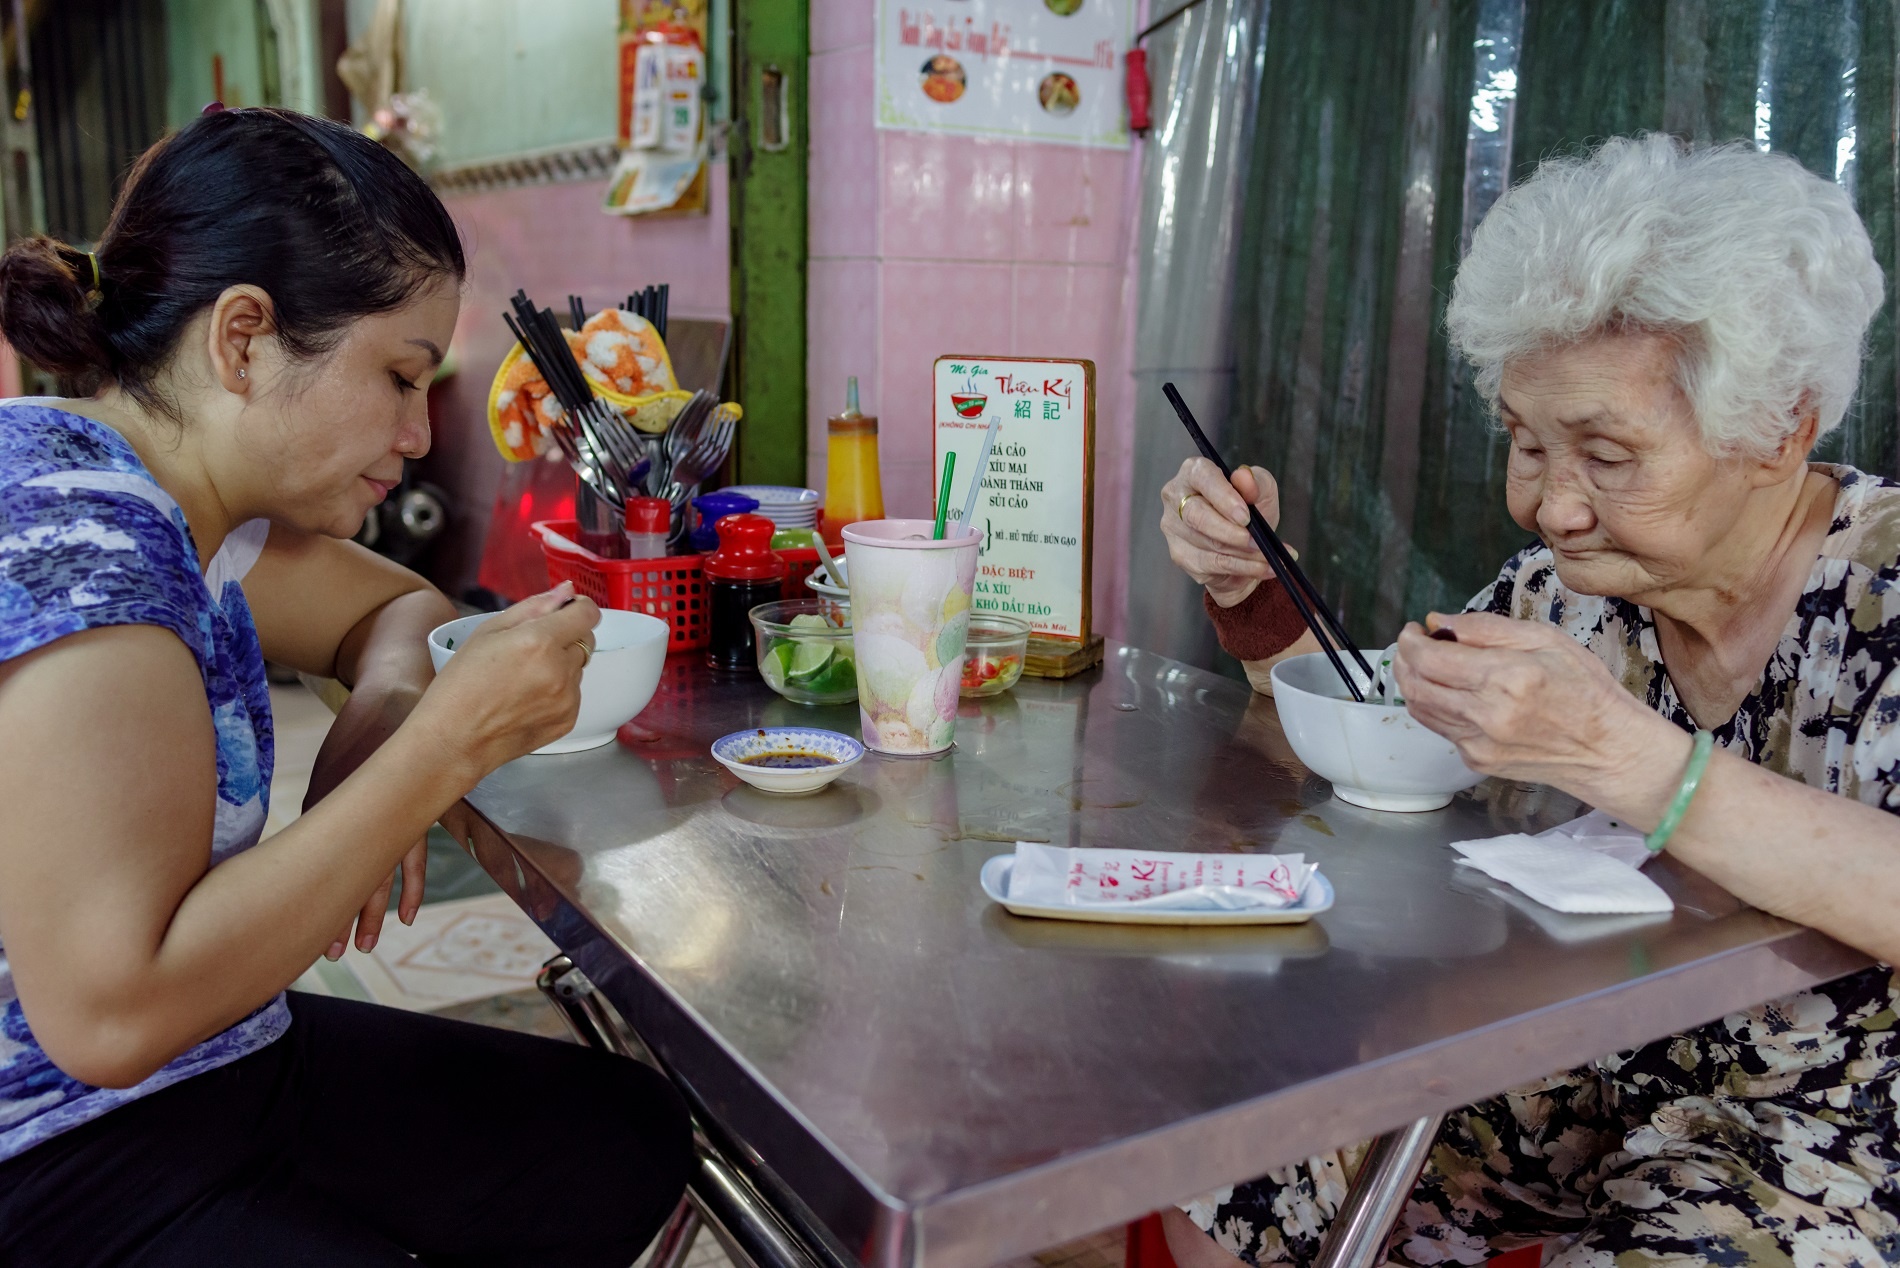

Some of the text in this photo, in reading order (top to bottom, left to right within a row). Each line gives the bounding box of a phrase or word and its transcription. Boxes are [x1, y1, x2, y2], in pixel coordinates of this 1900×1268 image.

[971, 365, 989, 377] Gia
[995, 373, 1073, 410] Thiệu Ký
[1006, 442, 1026, 457] CẢO
[989, 459, 1027, 476] XÍU MẠI
[980, 475, 1044, 492] OÀNH THÁNH
[989, 492, 1028, 509] SỦI CẢO
[1021, 530, 1039, 543] TIẾU
[1060, 536, 1077, 547] GẠO
[982, 565, 1035, 581] ĐẶC BIỆT
[975, 580, 1011, 595] XÁ XÍU
[976, 598, 999, 610] KHÔ
[1028, 602, 1052, 616] HÀO
